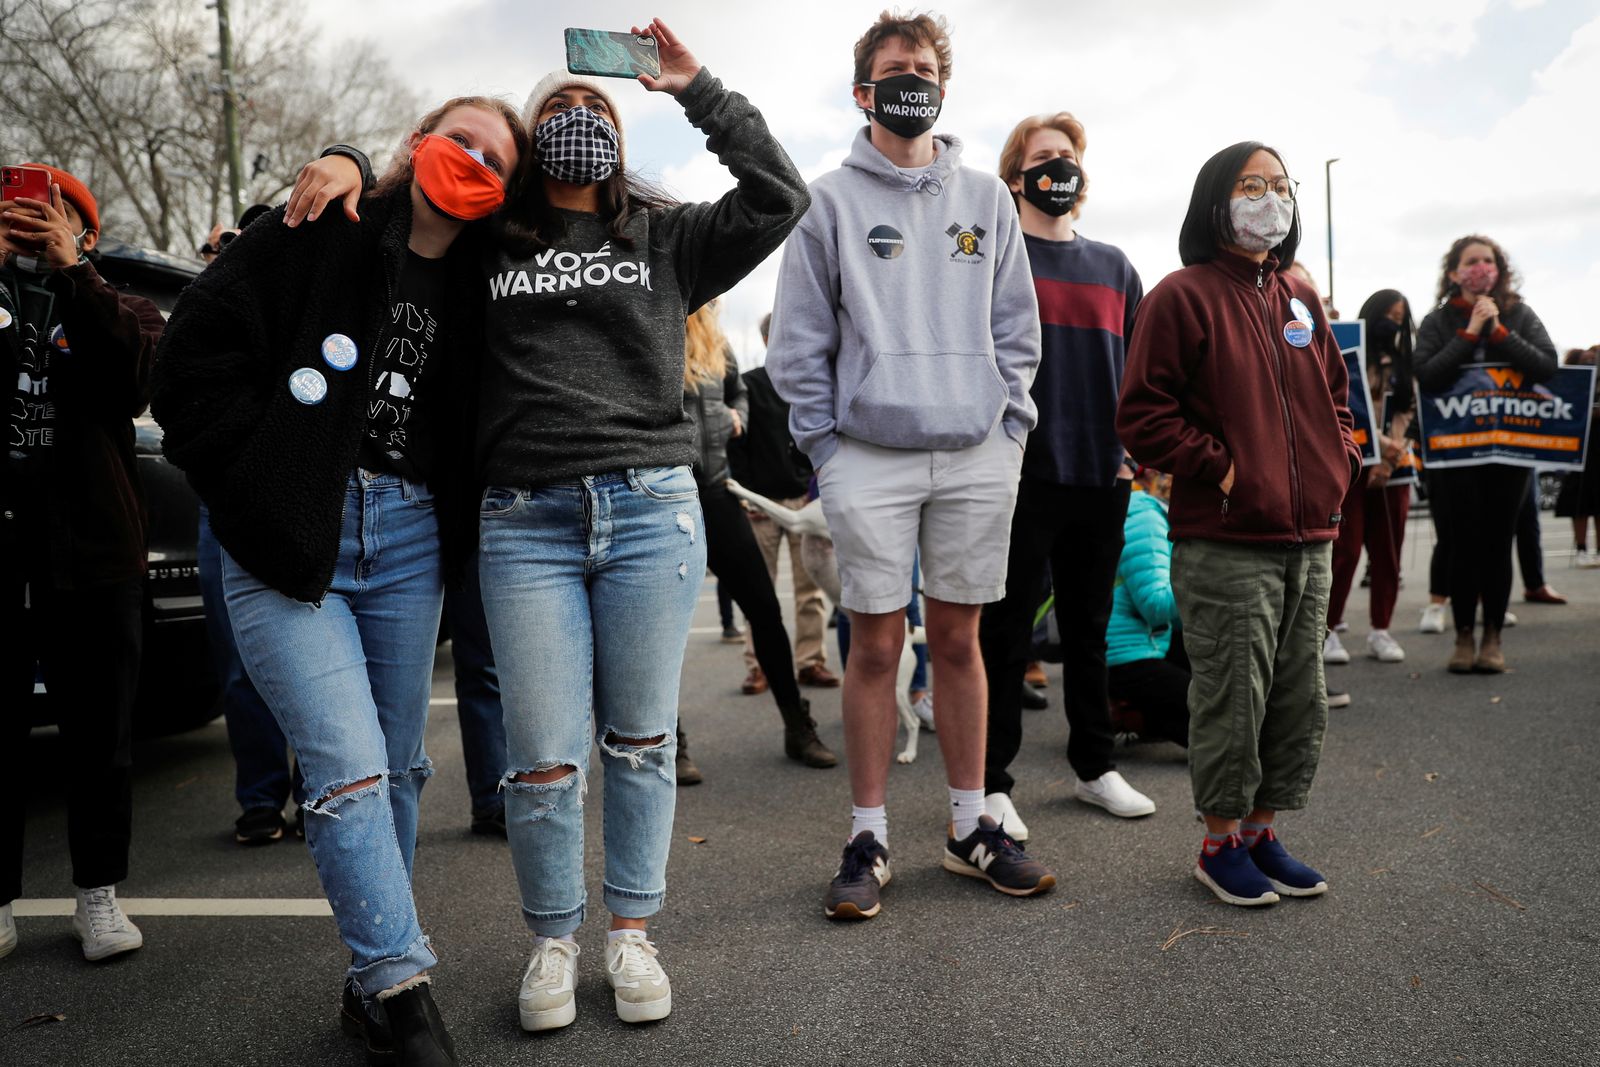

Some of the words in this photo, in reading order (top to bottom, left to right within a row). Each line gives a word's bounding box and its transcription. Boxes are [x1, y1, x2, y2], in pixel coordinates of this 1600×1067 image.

[882, 103, 938, 118] WARNOCK
[900, 91, 929, 104] VOTE
[534, 240, 612, 272] VOTE
[489, 261, 653, 301] WARNOCK
[1434, 394, 1574, 421] Warnock
